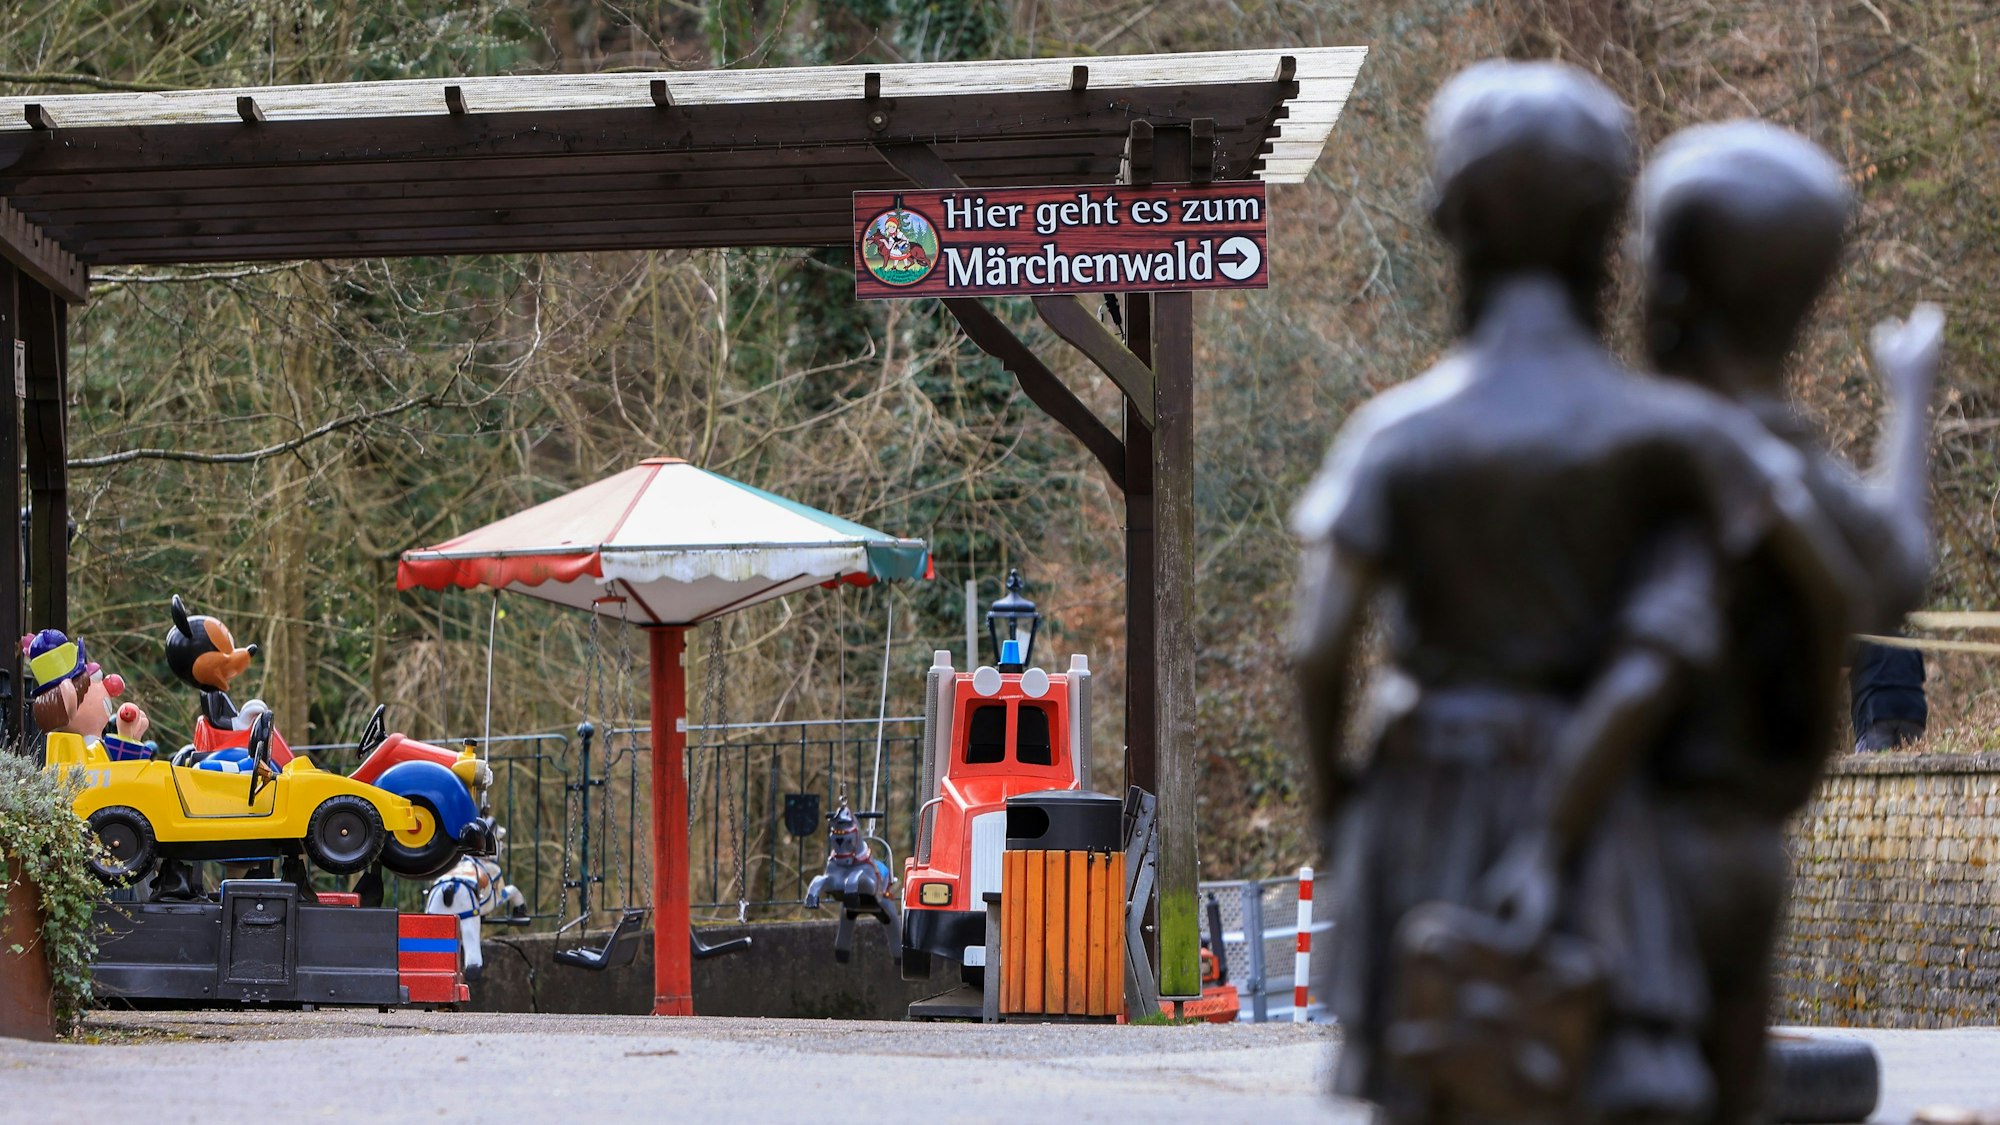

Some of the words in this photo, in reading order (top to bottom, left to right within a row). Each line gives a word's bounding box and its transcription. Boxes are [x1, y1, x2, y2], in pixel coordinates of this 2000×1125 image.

[943, 197, 1023, 229] Hier
[1036, 193, 1119, 234] geht
[1131, 201, 1169, 223] es
[1182, 198, 1260, 222] zum
[943, 239, 1212, 287] Märchenwald
